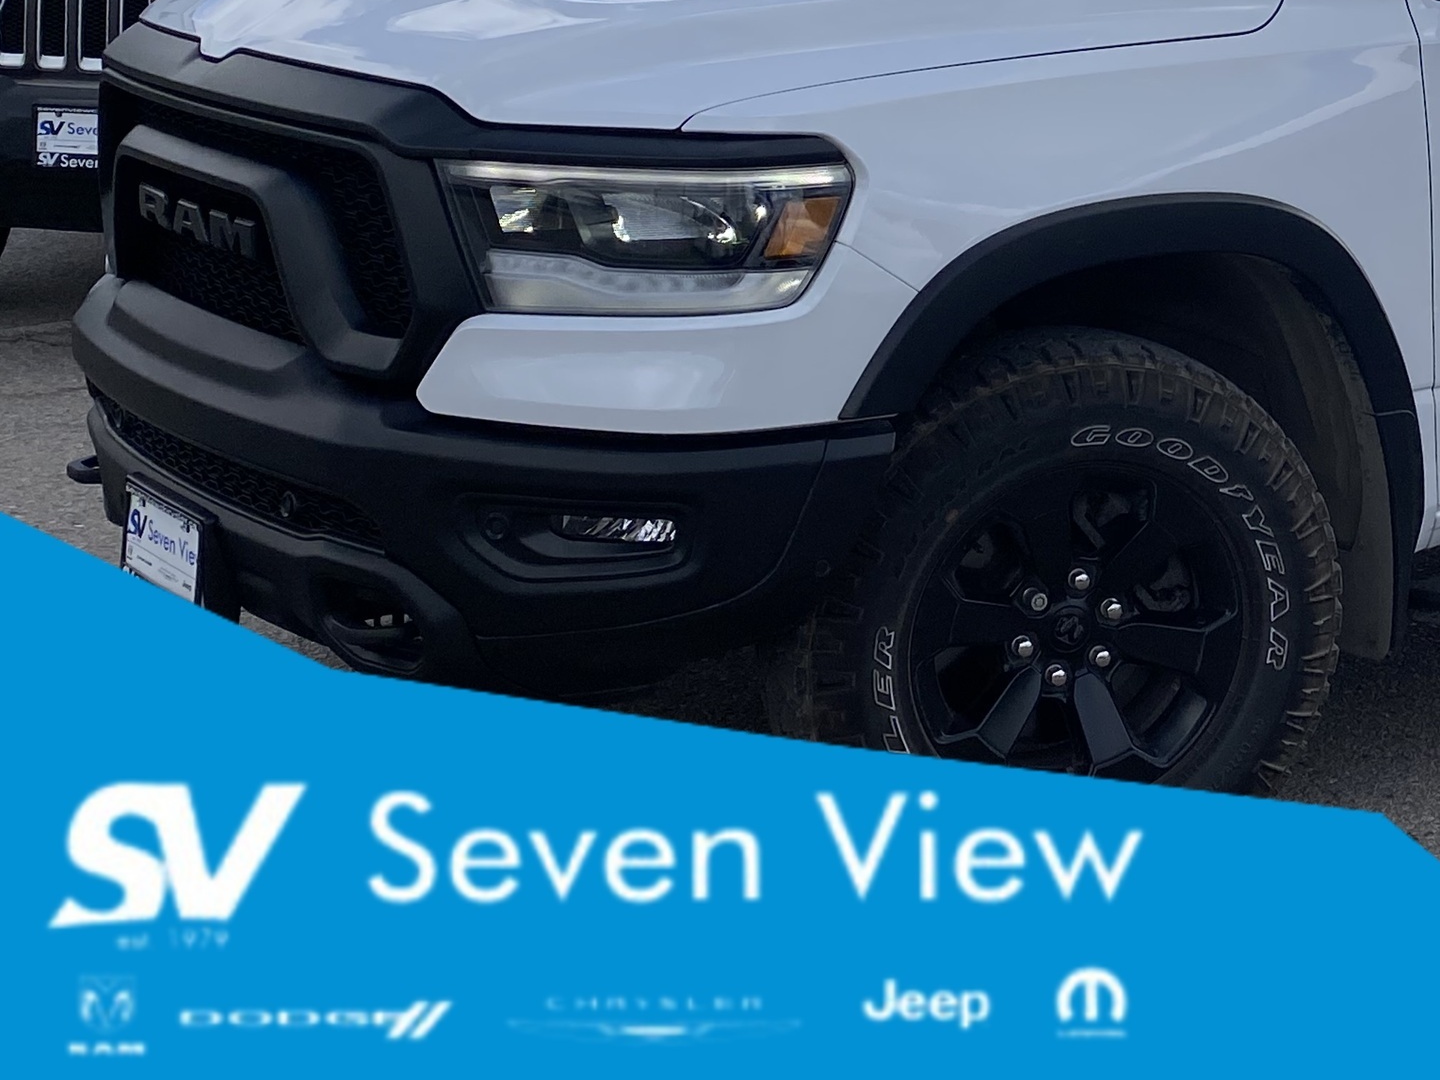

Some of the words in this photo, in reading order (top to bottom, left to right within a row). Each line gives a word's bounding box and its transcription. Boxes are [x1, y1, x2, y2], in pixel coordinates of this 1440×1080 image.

[38, 120, 65, 135] SV
[37, 152, 59, 167] SV
[139, 181, 257, 259] RAM
[127, 508, 147, 539] SV
[148, 519, 176, 555] Seven
[179, 537, 197, 566] Vie
[1071, 424, 1290, 671] GOODYEAR
